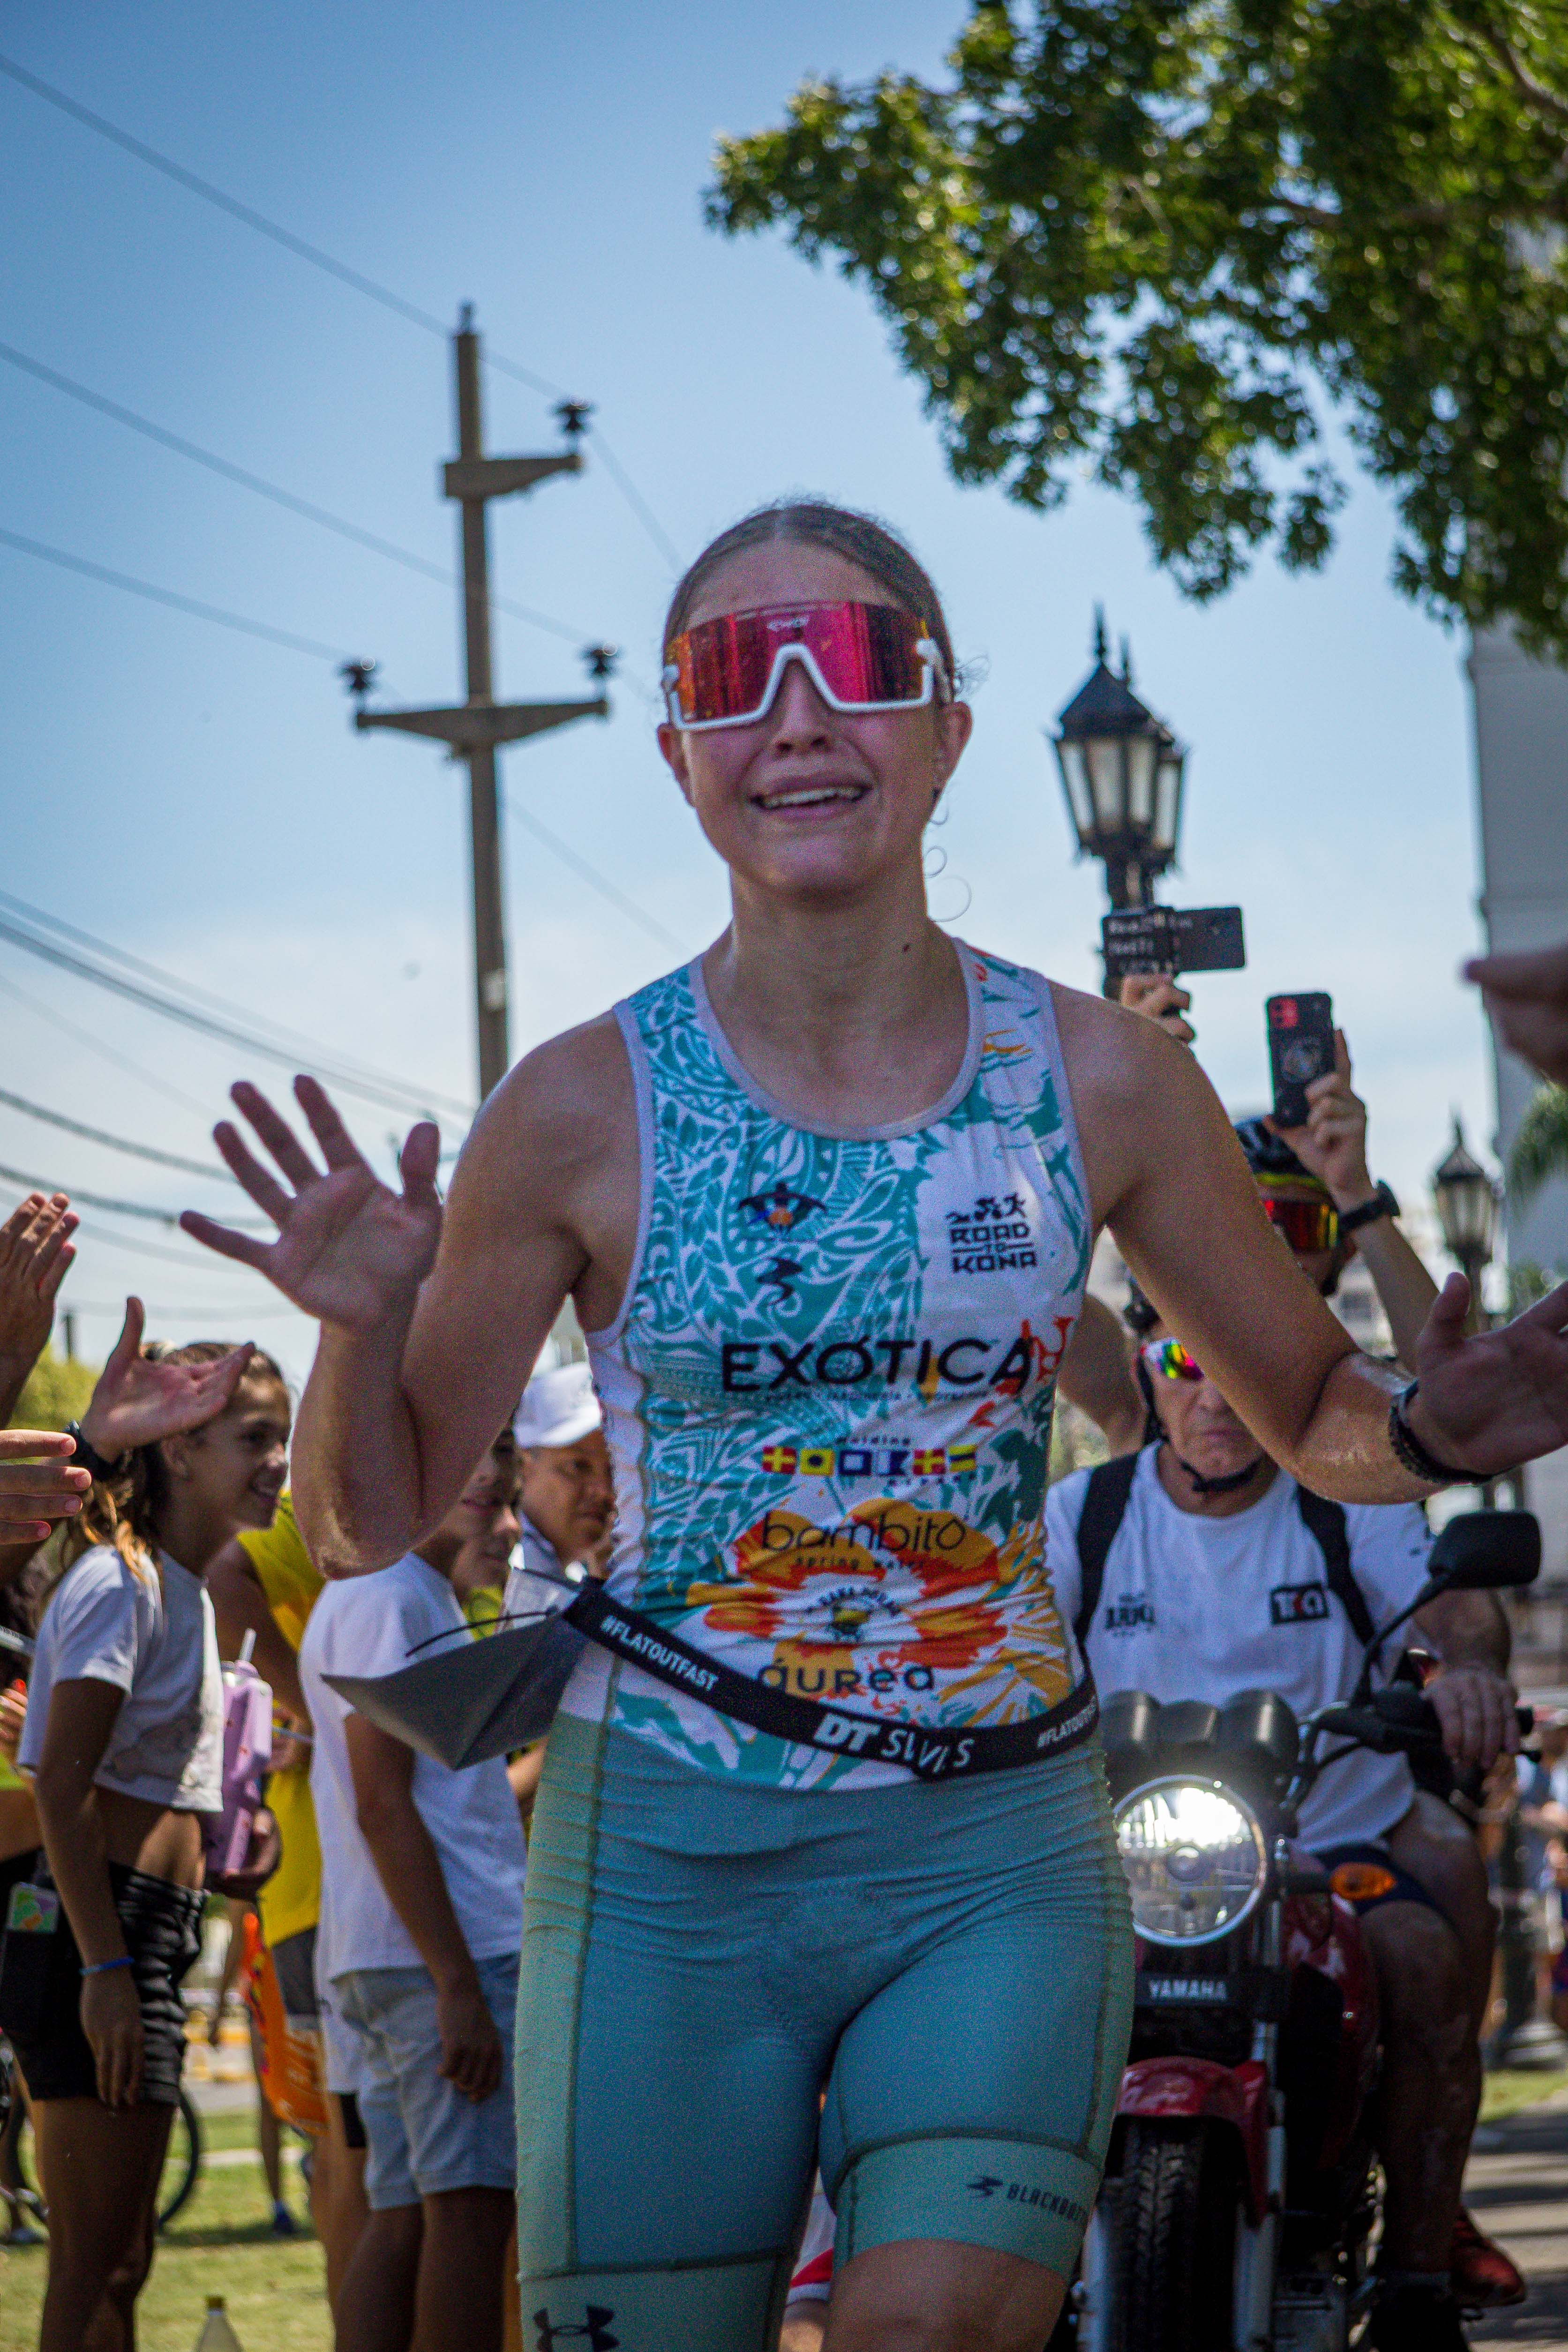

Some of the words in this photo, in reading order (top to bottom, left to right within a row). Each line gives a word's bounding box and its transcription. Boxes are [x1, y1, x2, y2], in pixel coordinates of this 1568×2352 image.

[950, 1222, 1030, 1243] ROAD
[985, 1242, 1006, 1254] TO
[951, 1250, 1038, 1274] KONA
[722, 1335, 1033, 1393] EXÓTICA
[600, 1615, 719, 1691] #FLATOUTFAST
[814, 1713, 882, 1753] DT
[1149, 1979, 1227, 2000] YAMAHA
